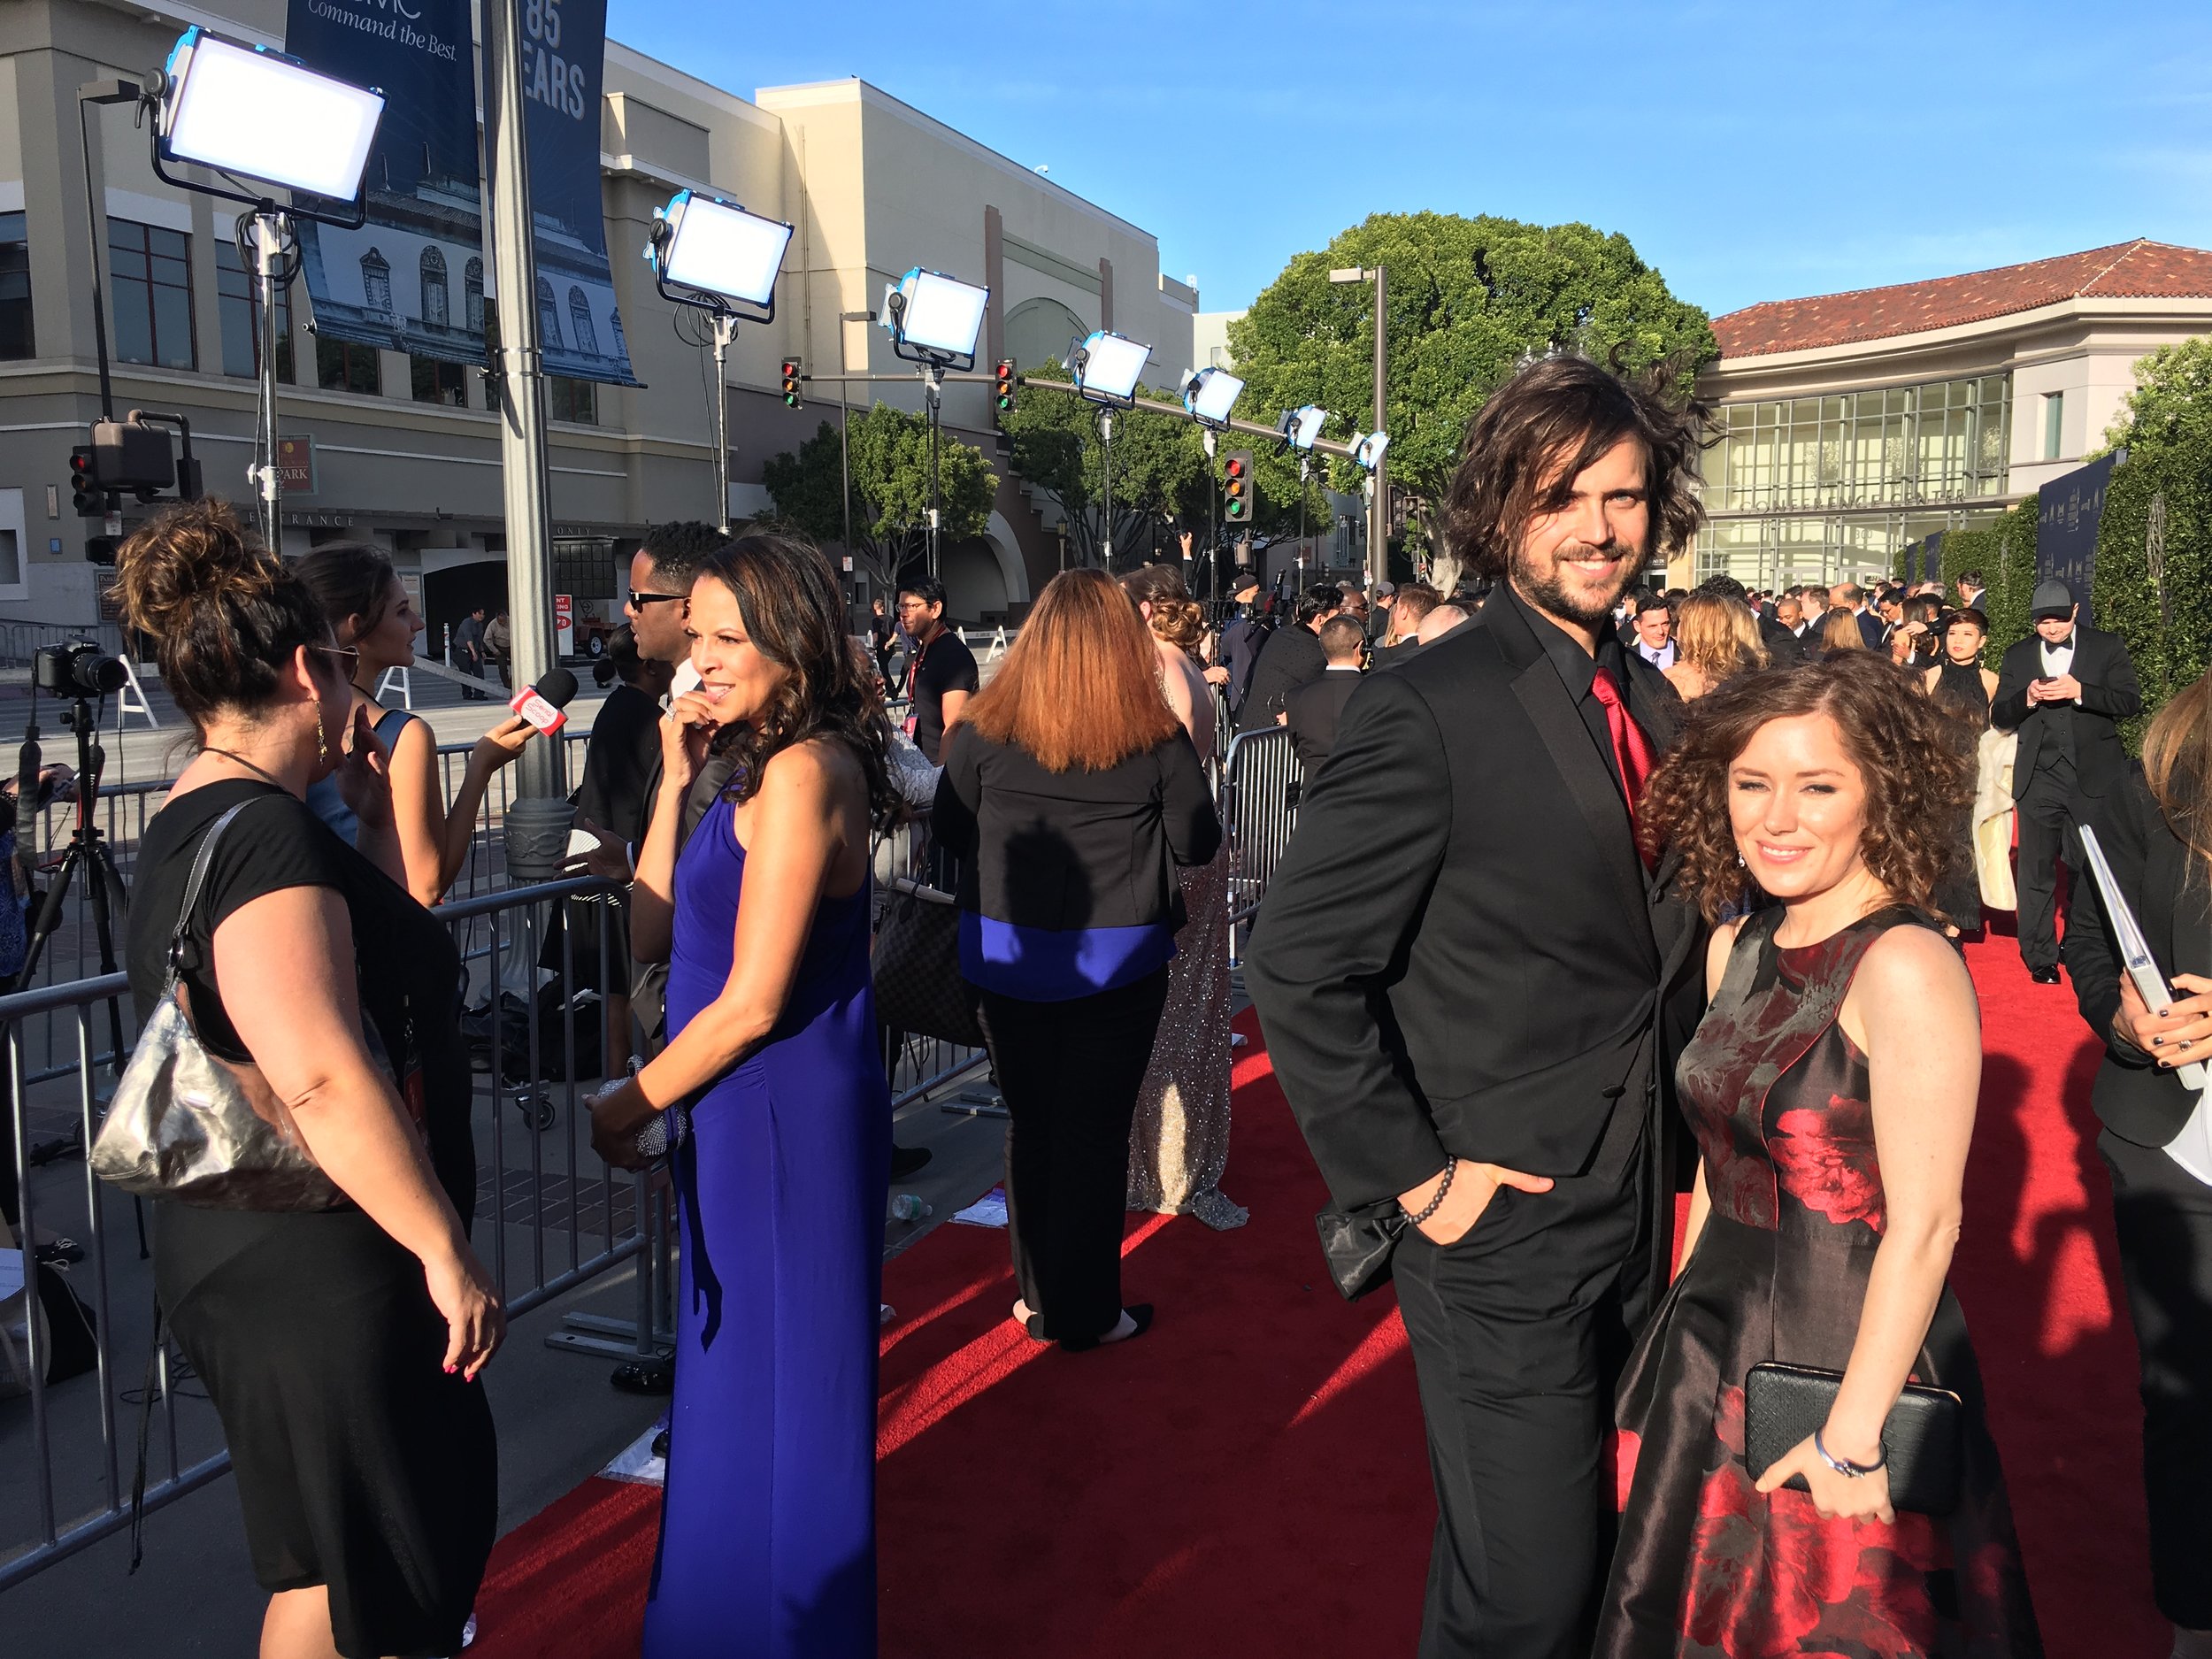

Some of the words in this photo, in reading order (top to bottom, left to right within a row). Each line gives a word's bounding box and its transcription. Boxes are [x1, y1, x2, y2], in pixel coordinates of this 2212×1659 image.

[308, 0, 396, 40] Command
[400, 25, 426, 49] the
[427, 34, 457, 62] Best.
[526, 0, 561, 50] 85
[1740, 493, 1881, 515] CONFERENCE
[1891, 488, 1966, 507] CENTER
[249, 512, 354, 526] ENRANCE
[557, 526, 591, 536] ONLY
[525, 703, 549, 724] Scoop
